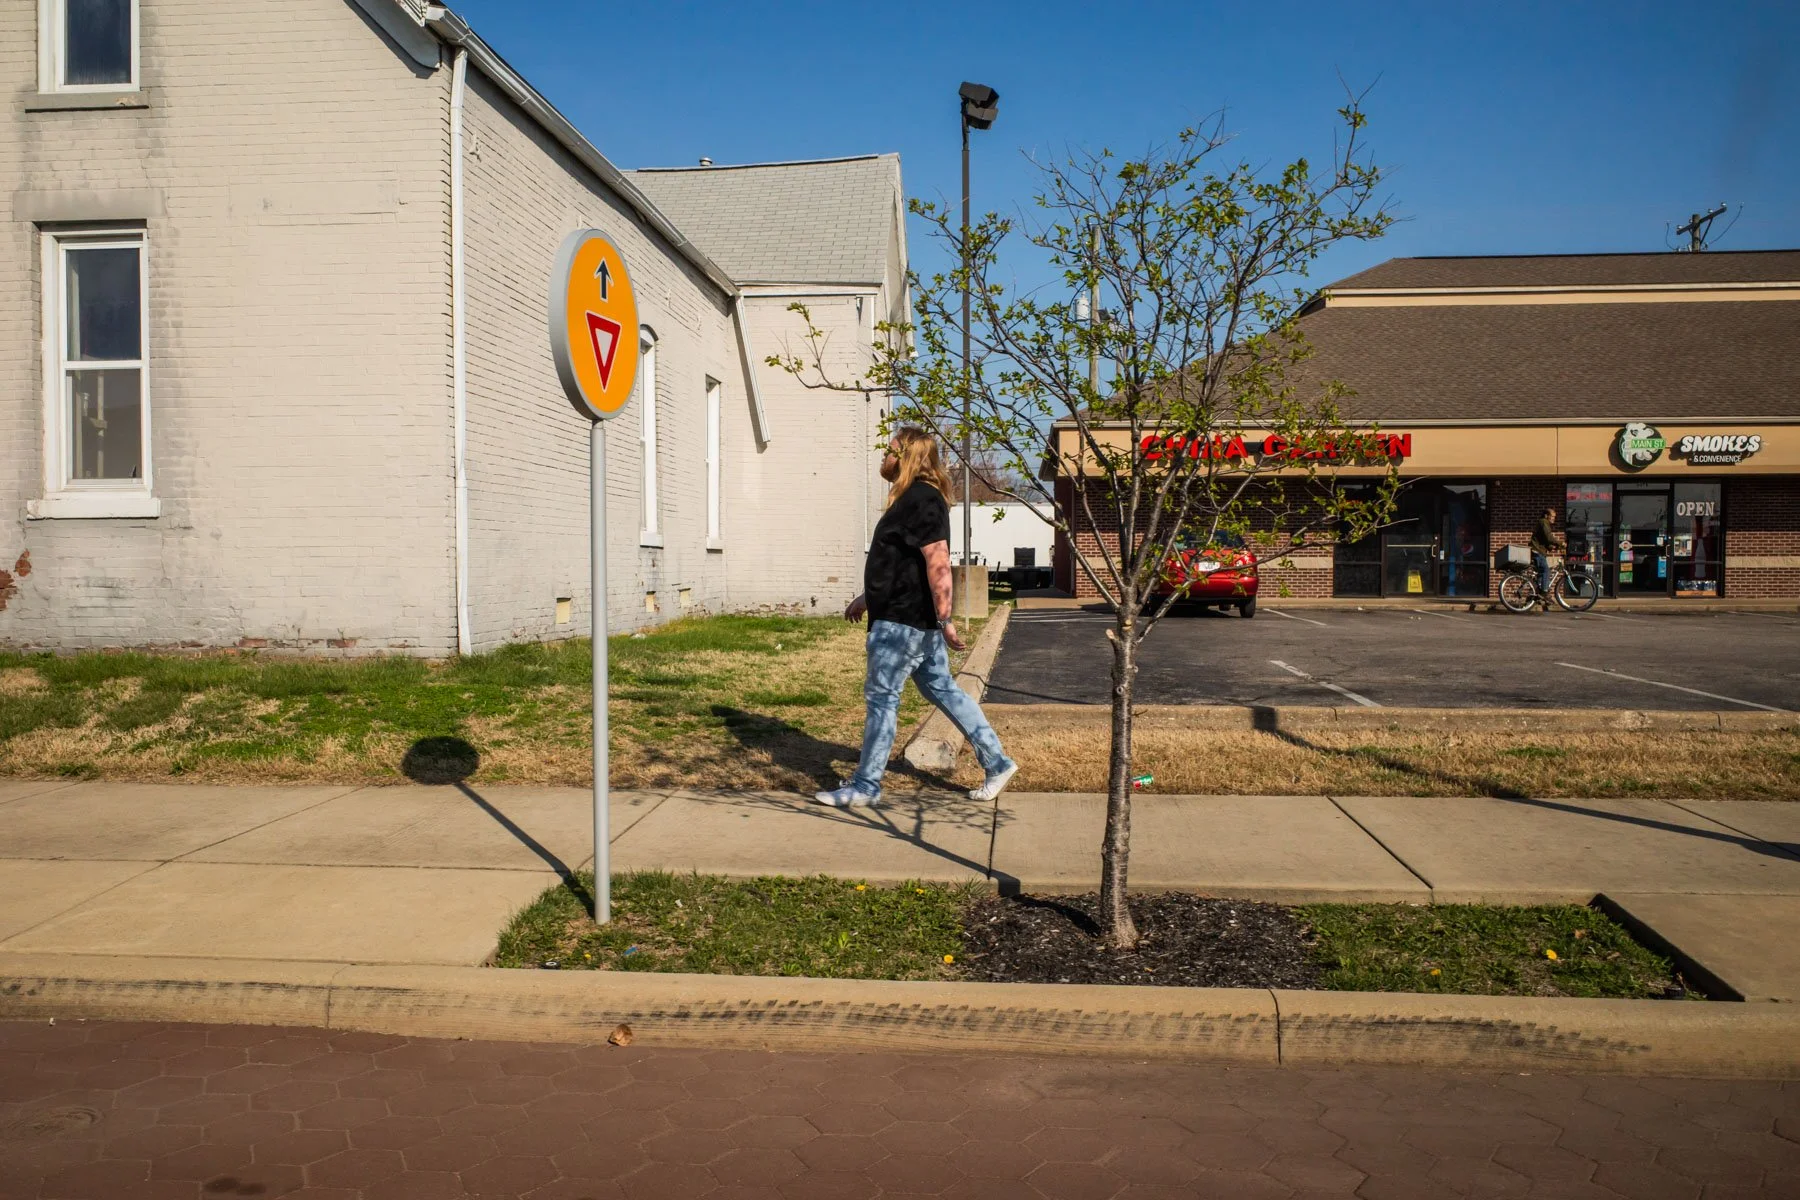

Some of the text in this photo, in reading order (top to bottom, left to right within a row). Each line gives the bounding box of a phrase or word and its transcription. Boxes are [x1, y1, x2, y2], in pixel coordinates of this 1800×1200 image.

[1263, 433, 1412, 460] GAREN
[1632, 440, 1664, 449] MAIN ST
[1681, 435, 1761, 453] SMOKES
[1699, 455, 1742, 463] CONVENIENCE
[1676, 501, 1715, 516] OPEN
